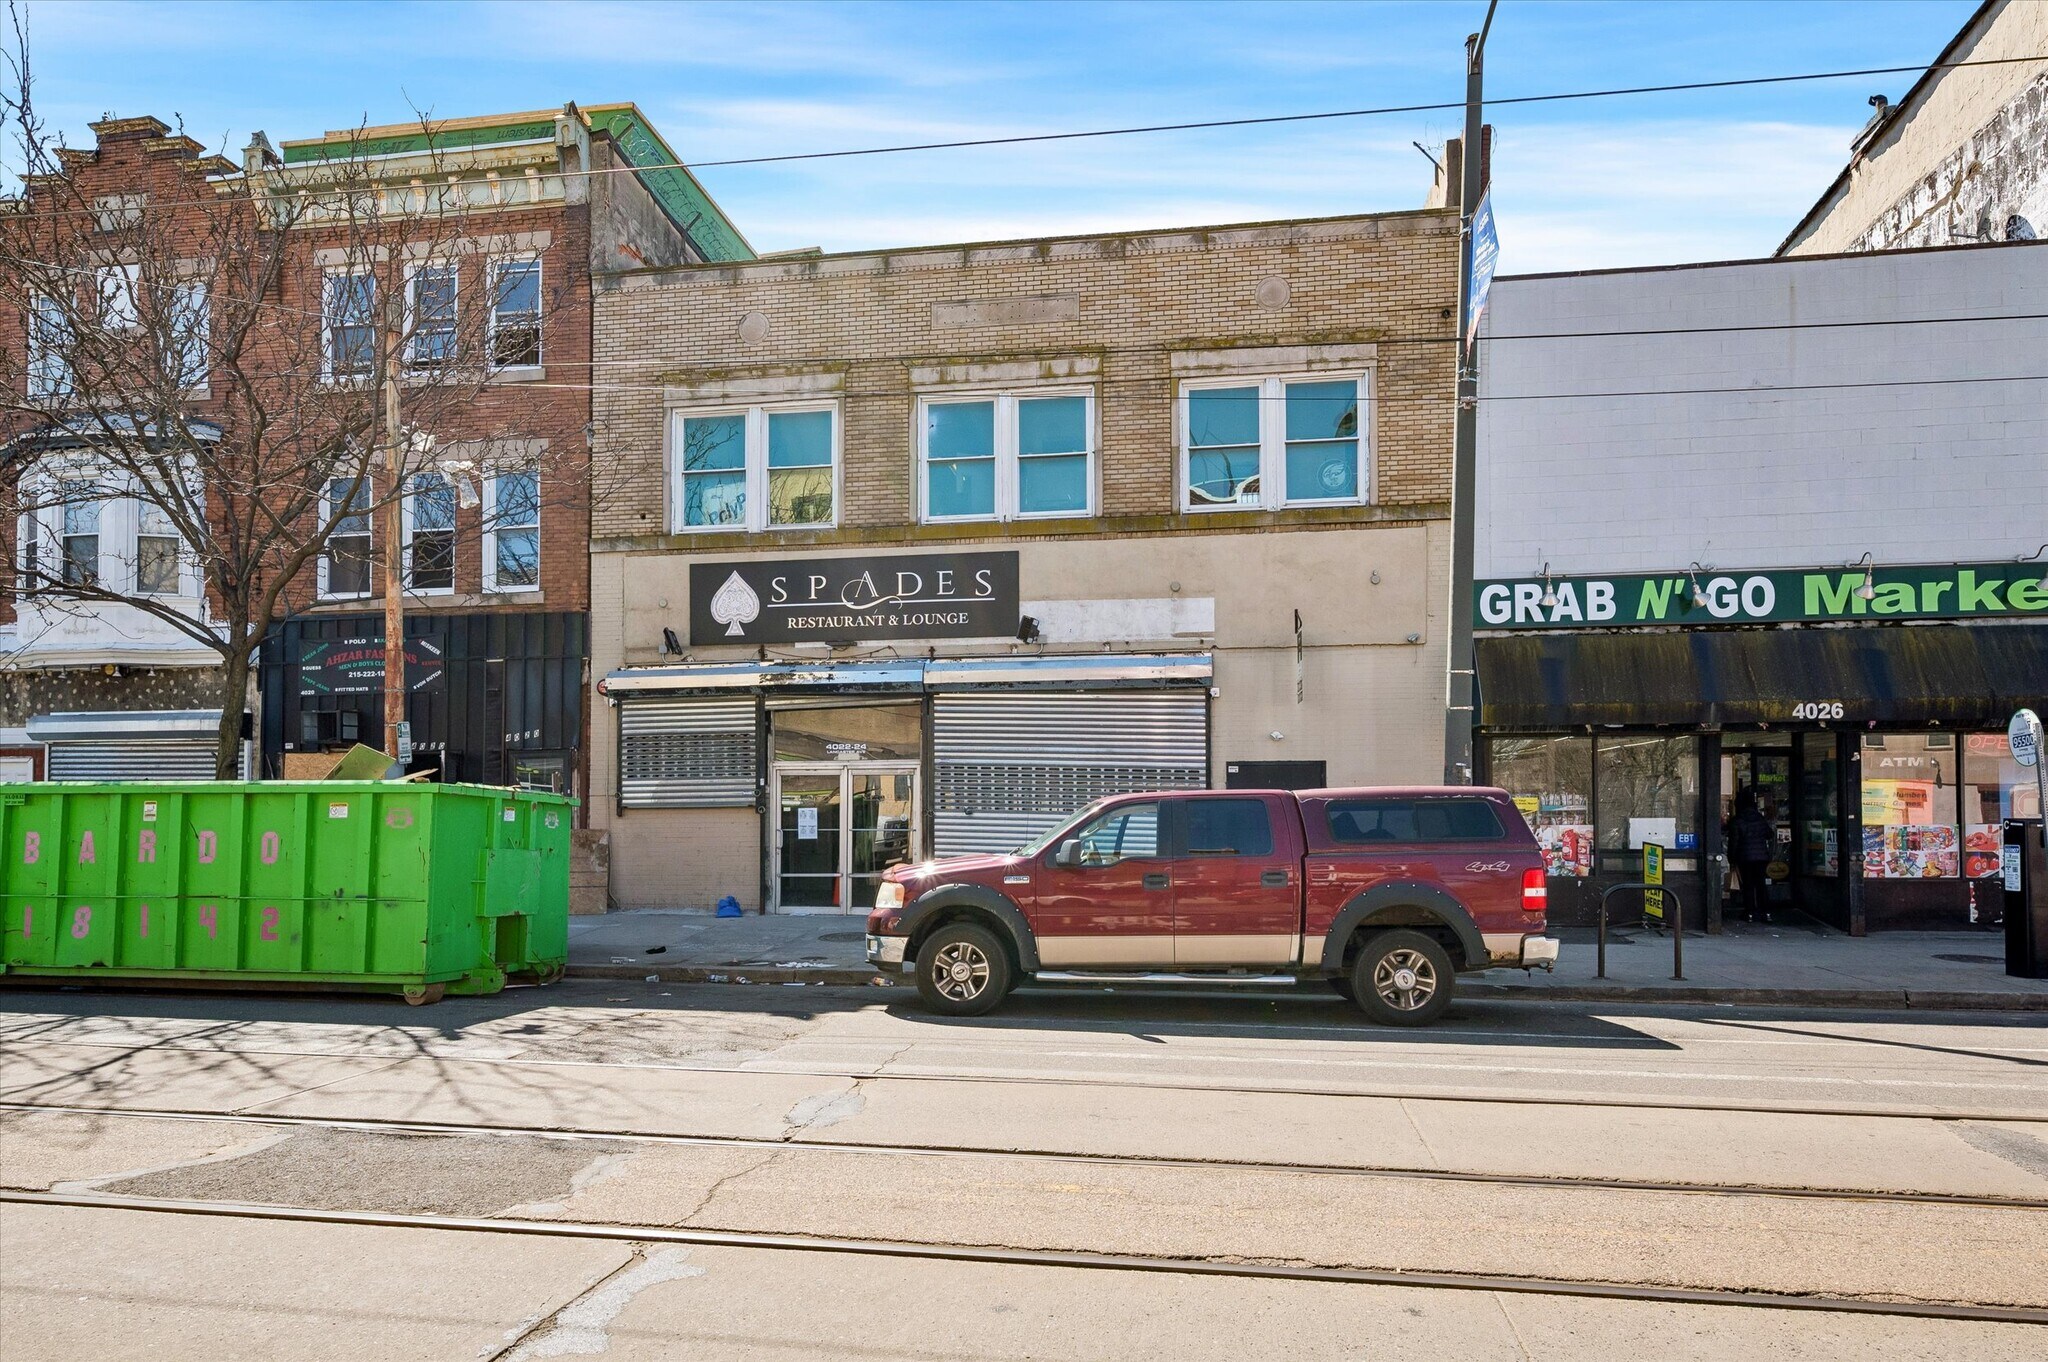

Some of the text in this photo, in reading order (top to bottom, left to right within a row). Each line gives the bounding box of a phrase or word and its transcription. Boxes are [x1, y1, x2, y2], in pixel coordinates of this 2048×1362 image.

[771, 569, 992, 607] SPADES
[1480, 581, 1617, 624] GRAB
[1705, 576, 1776, 619] GO
[787, 612, 969, 629] RESTAURANT & LOUNGE
[325, 649, 418, 667] AHZAR FASNS
[1792, 703, 1844, 719] 4026
[506, 729, 540, 742] 4020
[1968, 735, 2009, 749] OPE
[1880, 757, 1923, 767] ATM
[1678, 833, 1695, 844] EBT
[24, 830, 280, 865] BARDO
[24, 905, 280, 941] 18142
